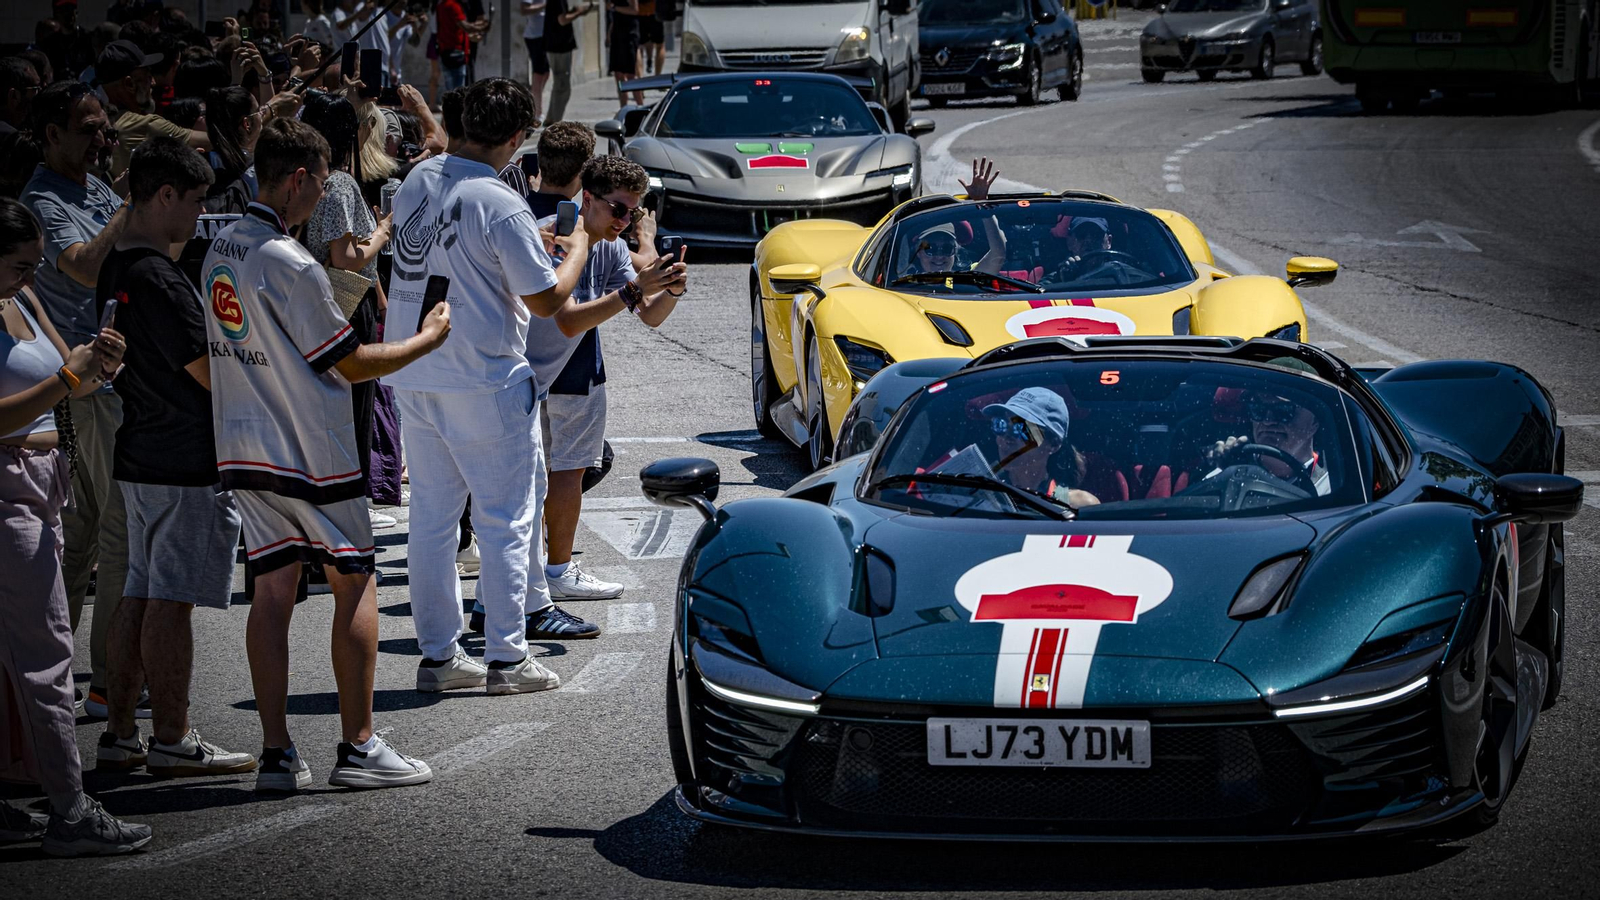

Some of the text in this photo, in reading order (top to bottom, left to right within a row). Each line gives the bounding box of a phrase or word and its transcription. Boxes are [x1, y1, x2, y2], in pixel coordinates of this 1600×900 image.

[213, 238, 249, 261] GIANNI
[1100, 370, 1120, 385] 5
[944, 724, 1134, 762] LJ73 YDM
